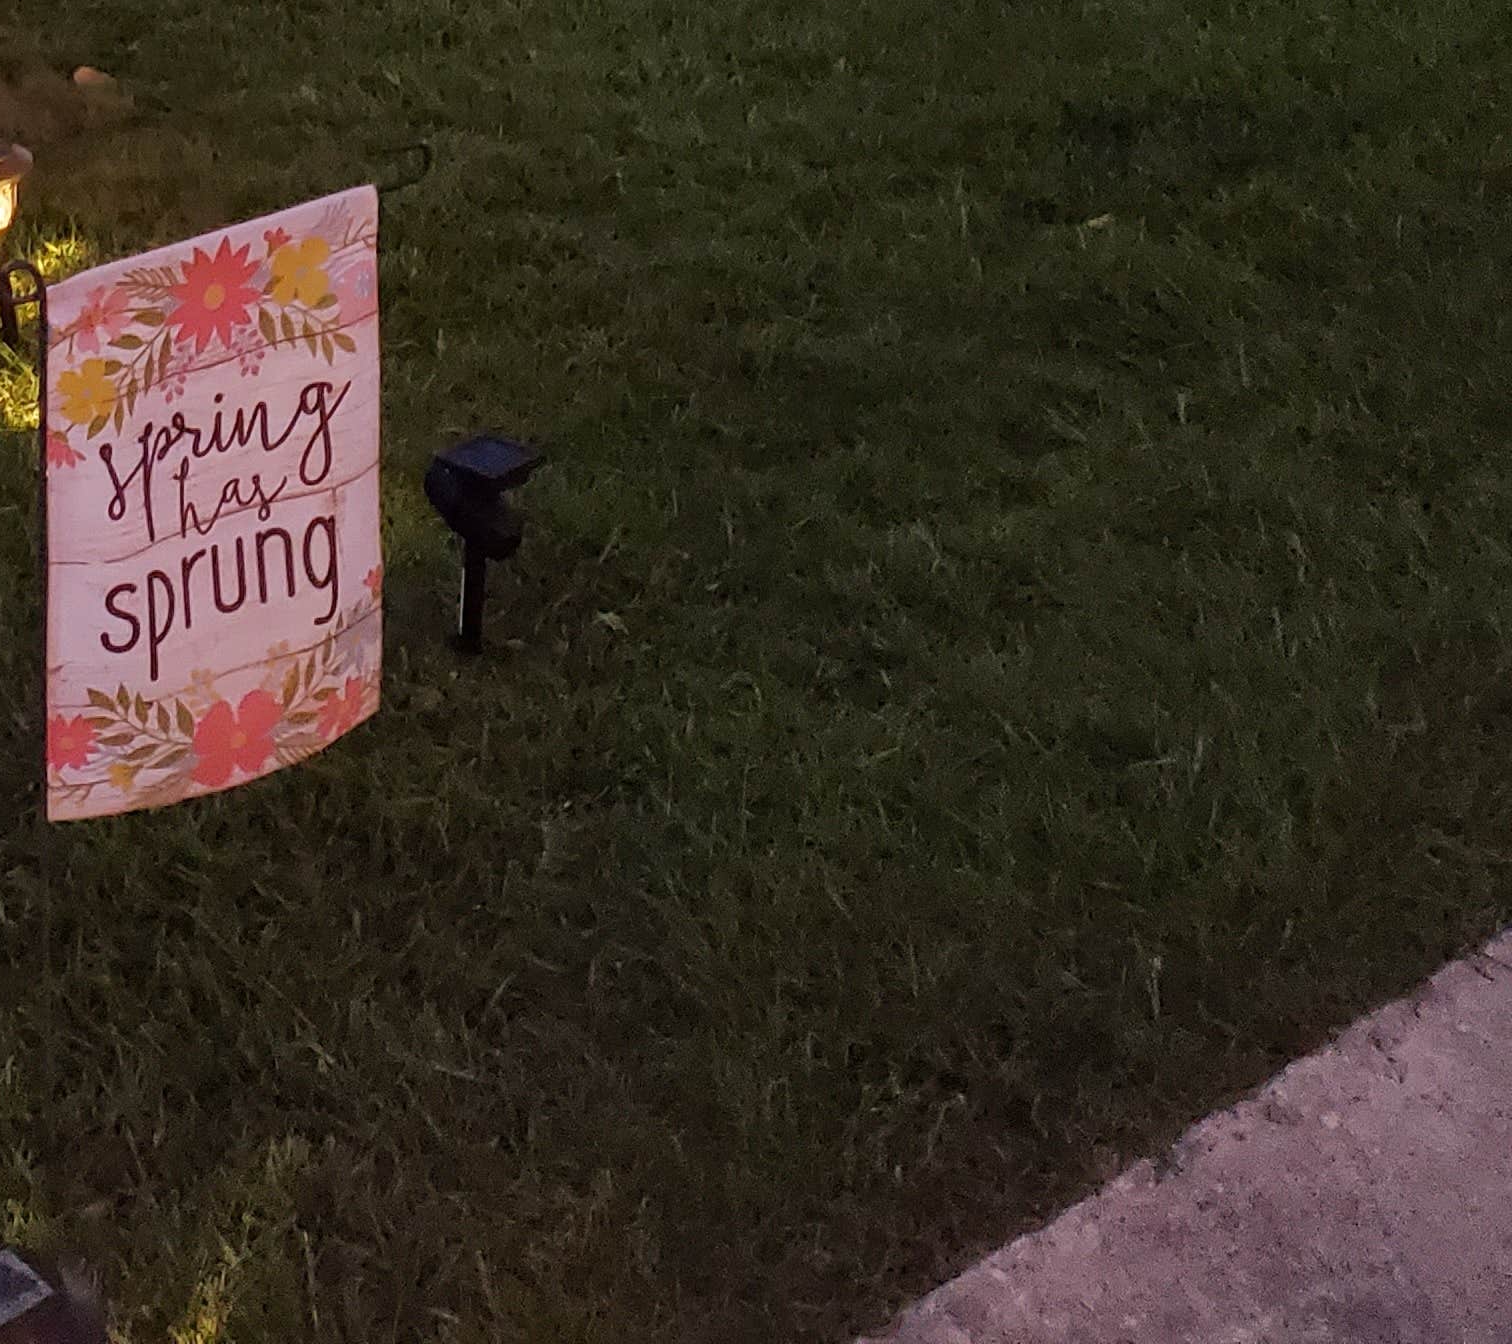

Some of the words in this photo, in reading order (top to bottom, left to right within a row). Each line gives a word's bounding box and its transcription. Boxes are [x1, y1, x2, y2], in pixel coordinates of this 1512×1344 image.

[99, 380, 352, 542] spring
[172, 456, 286, 539] has
[100, 515, 340, 682] sprung
